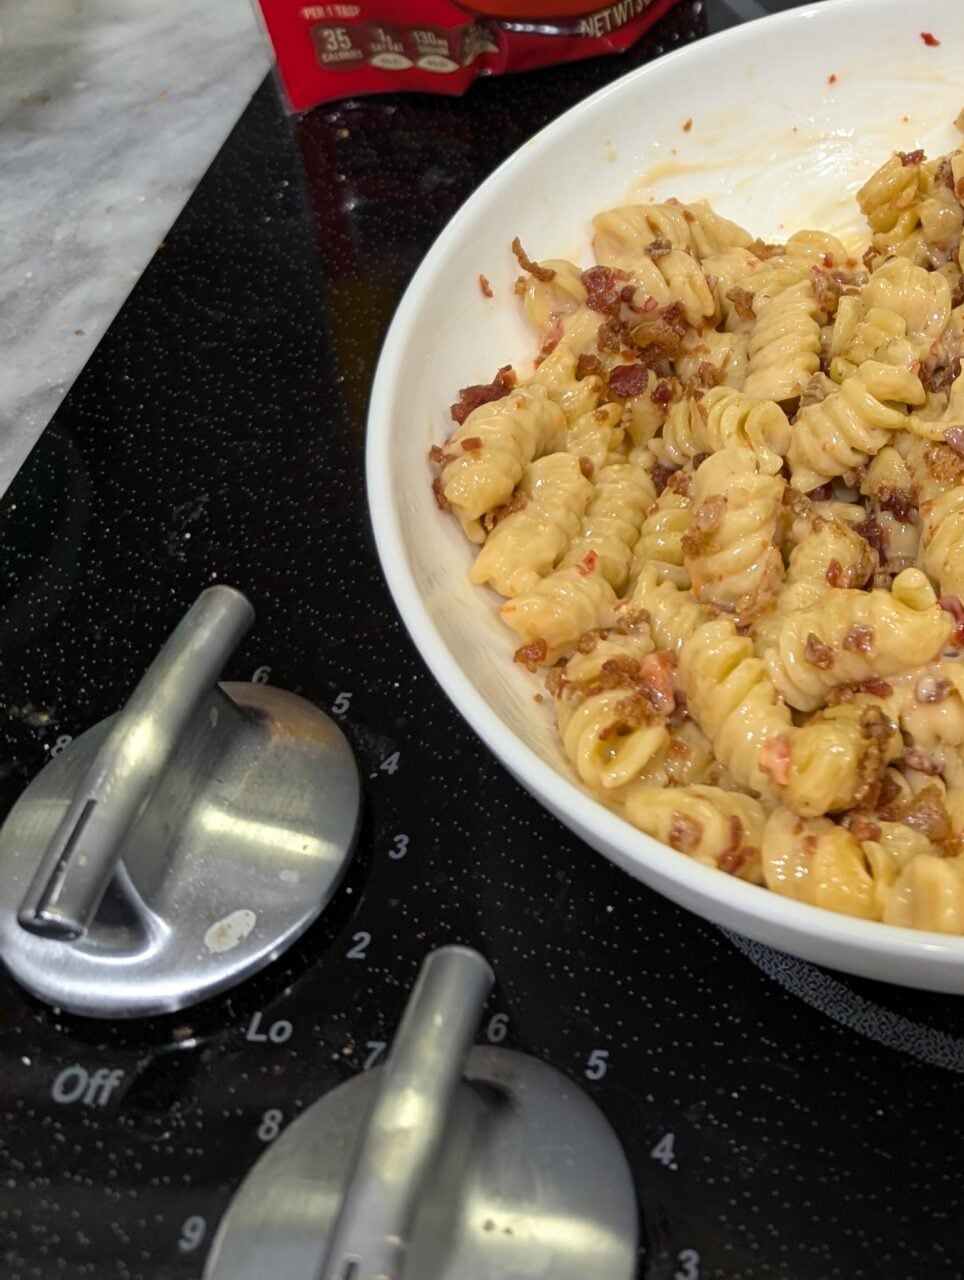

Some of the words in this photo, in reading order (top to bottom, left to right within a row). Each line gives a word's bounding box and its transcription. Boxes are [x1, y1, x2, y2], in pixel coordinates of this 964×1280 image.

[302, 5, 326, 20] PER
[581, 8, 612, 37] NET
[323, 27, 352, 51] 35
[252, 666, 271, 684] 6
[332, 692, 352, 714] 5
[380, 751, 400, 775] 4
[388, 834, 409, 859] 3
[347, 932, 371, 959] 2
[247, 1012, 292, 1043] Lo
[487, 1013, 509, 1043] 6
[364, 1041, 387, 1070] 7
[585, 1050, 609, 1080] 5
[51, 1066, 124, 1106] Off
[257, 1109, 284, 1142] 8
[651, 1132, 675, 1165] 4
[178, 1215, 206, 1253] 9
[674, 1249, 700, 1279] 3
